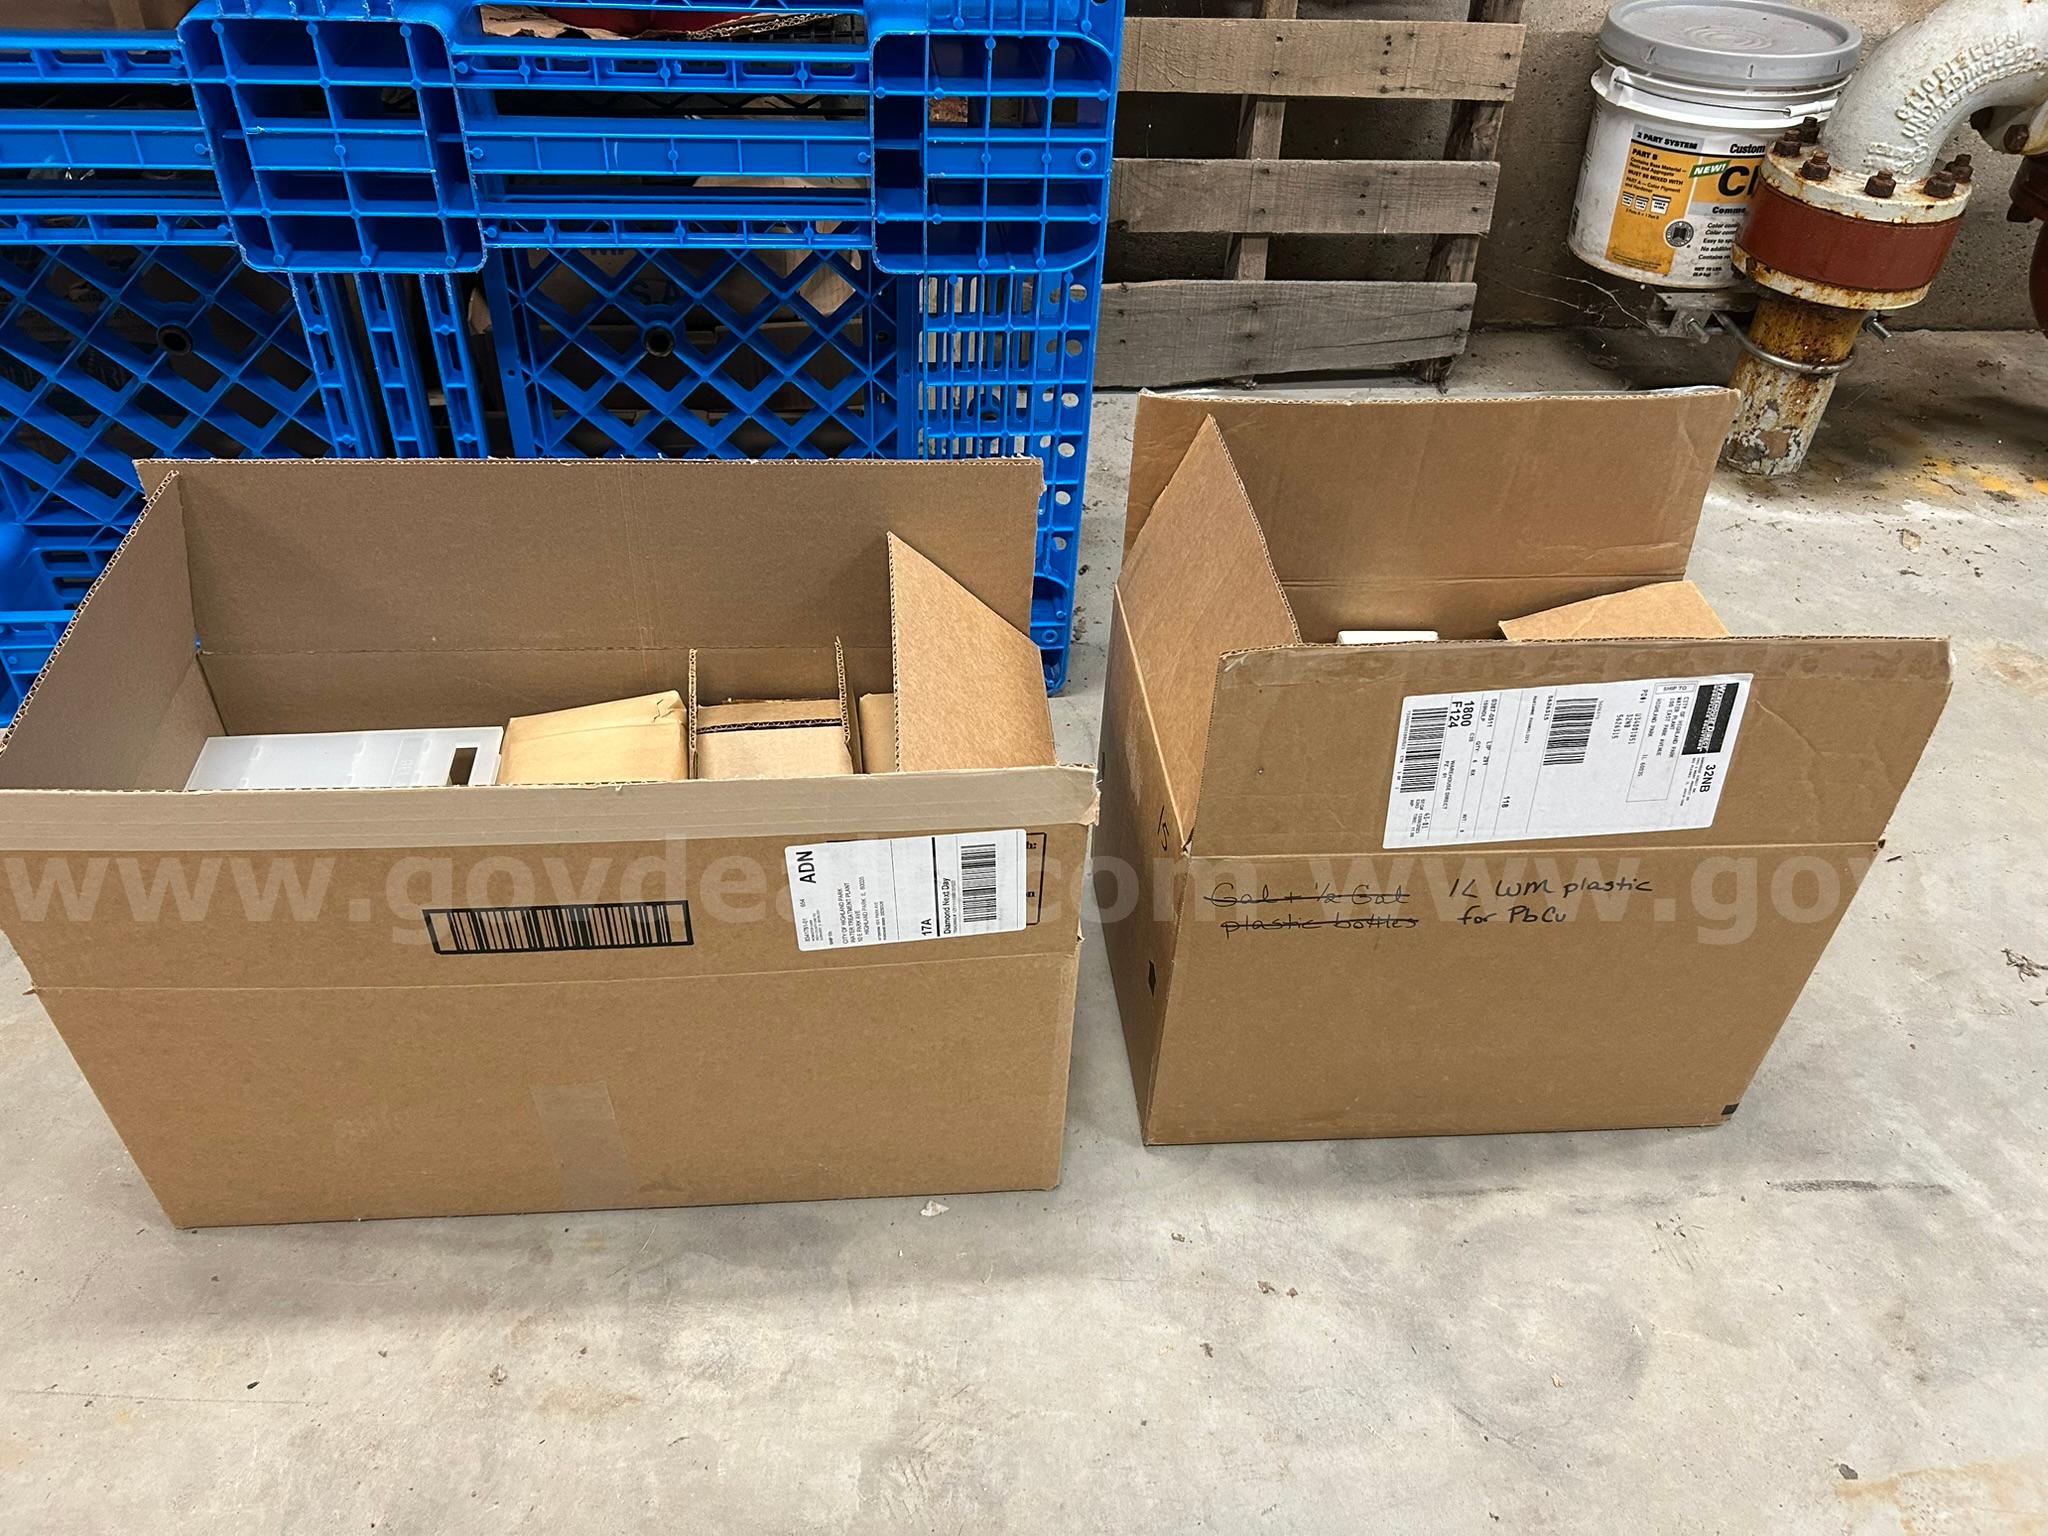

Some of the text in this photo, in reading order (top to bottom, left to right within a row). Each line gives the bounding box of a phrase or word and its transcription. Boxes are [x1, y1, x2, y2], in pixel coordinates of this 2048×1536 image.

[1643, 134, 1663, 143] PART
[1664, 139, 1698, 149] SYSTEM
[1730, 144, 1765, 154] Custom
[1632, 149, 1651, 158] PART
[1693, 164, 1727, 175] NEW!
[1448, 701, 1462, 728] F124
[1460, 700, 1475, 727] 1800
[1699, 764, 1716, 793] 32NB
[796, 851, 816, 883] ADN
[941, 877, 950, 889] Day
[1562, 876, 1653, 899] plastic
[1456, 904, 1497, 925] for
[920, 918, 932, 935] 17A
